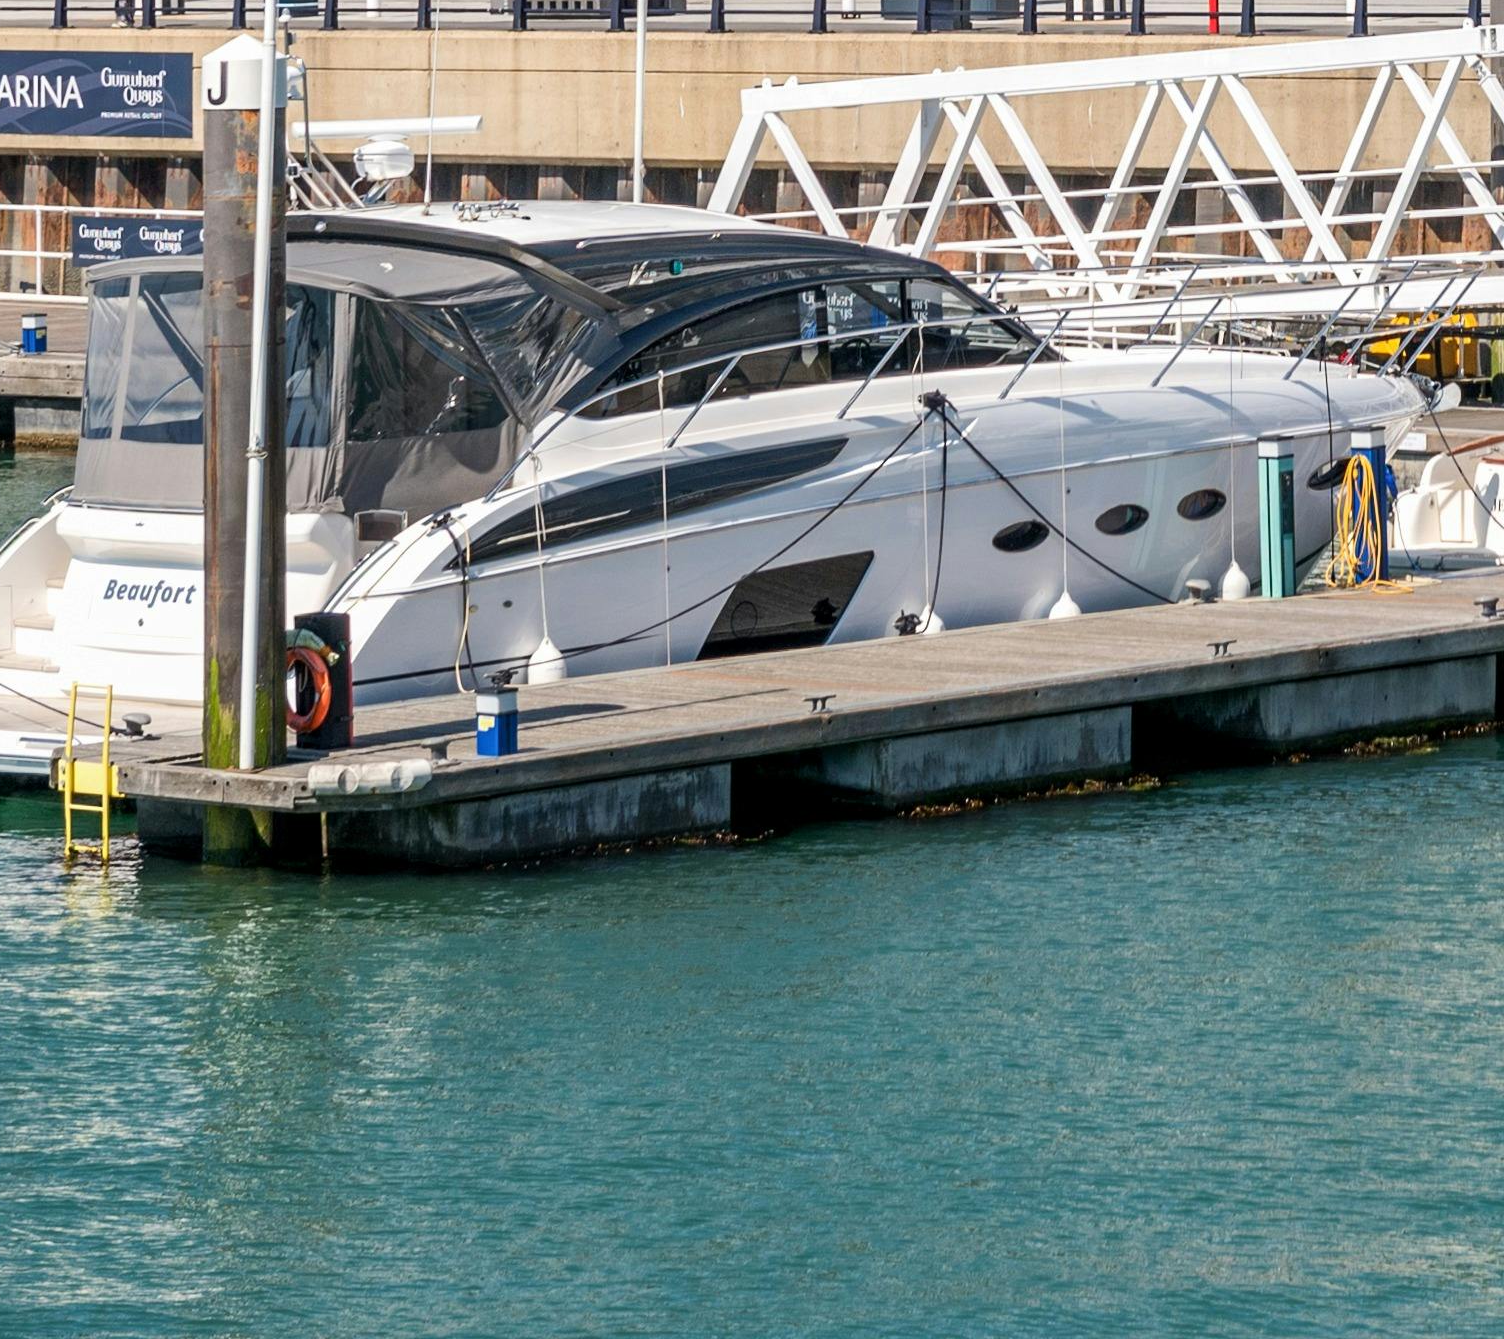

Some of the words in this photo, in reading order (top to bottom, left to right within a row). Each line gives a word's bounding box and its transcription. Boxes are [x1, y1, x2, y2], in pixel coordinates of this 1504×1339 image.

[100, 67, 167, 89] Gunwharf
[207, 61, 229, 106] J
[122, 85, 164, 108] Quays
[100, 111, 123, 120] PREMIUM
[142, 112, 163, 120] OUTLET
[78, 224, 124, 239] Gunwharf
[139, 225, 184, 241] Gunwharf
[93, 237, 122, 251] Quays
[154, 239, 182, 254] Quays
[103, 579, 197, 608] Beaufort
